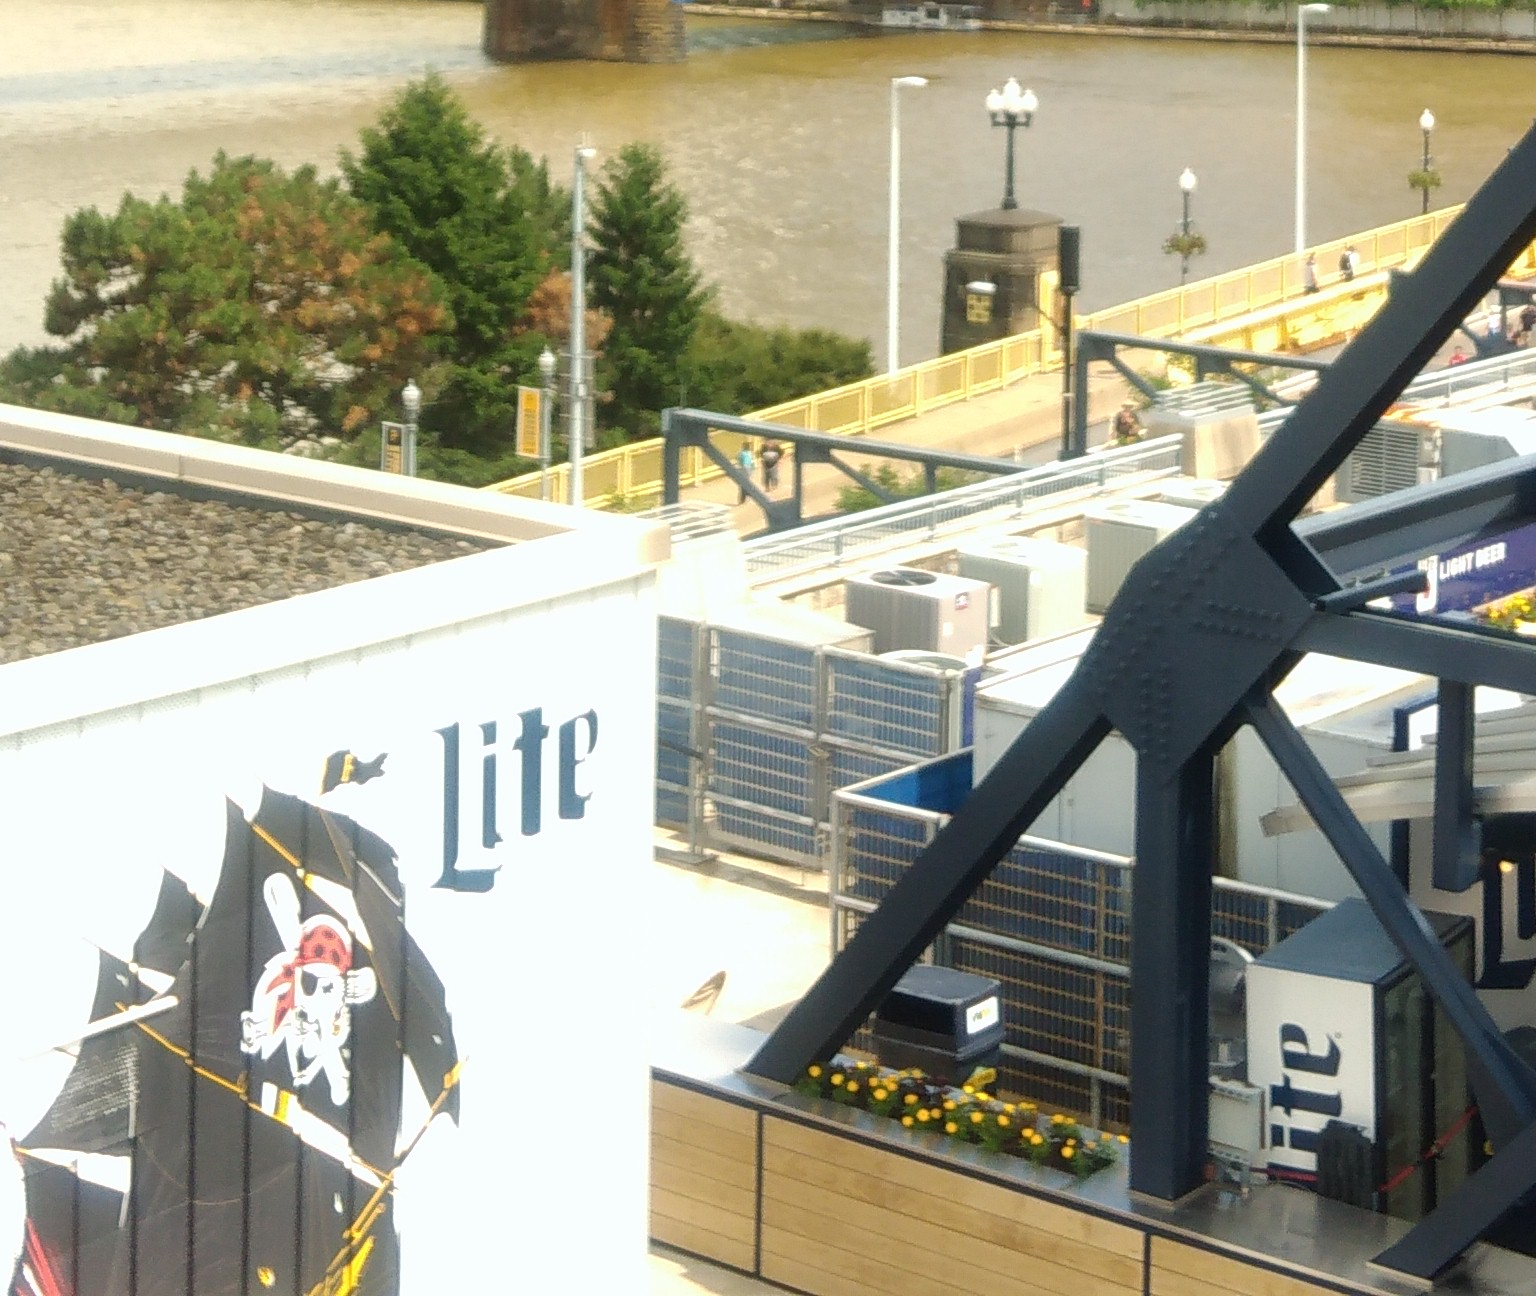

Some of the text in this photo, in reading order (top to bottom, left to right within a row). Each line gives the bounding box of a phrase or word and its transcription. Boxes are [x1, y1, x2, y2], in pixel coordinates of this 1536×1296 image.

[1440, 552, 1474, 581] LIGHT
[1474, 542, 1507, 570] BEER
[432, 707, 599, 893] Lite
